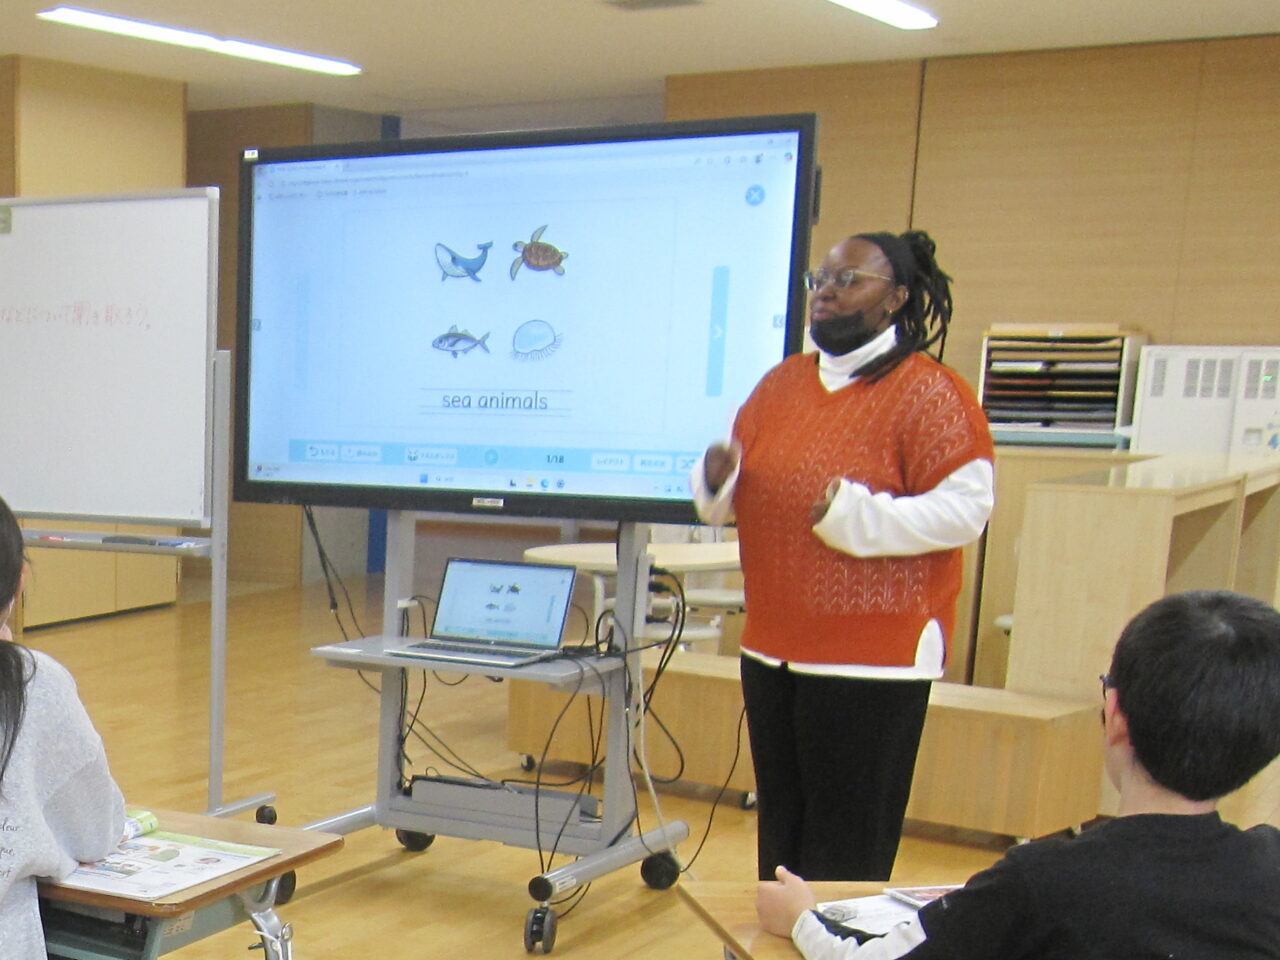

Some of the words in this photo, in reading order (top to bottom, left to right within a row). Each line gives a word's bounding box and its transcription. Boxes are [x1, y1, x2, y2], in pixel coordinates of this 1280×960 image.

[442, 394, 472, 409] sea
[478, 390, 548, 410] animals
[546, 455, 565, 464] 1/18
